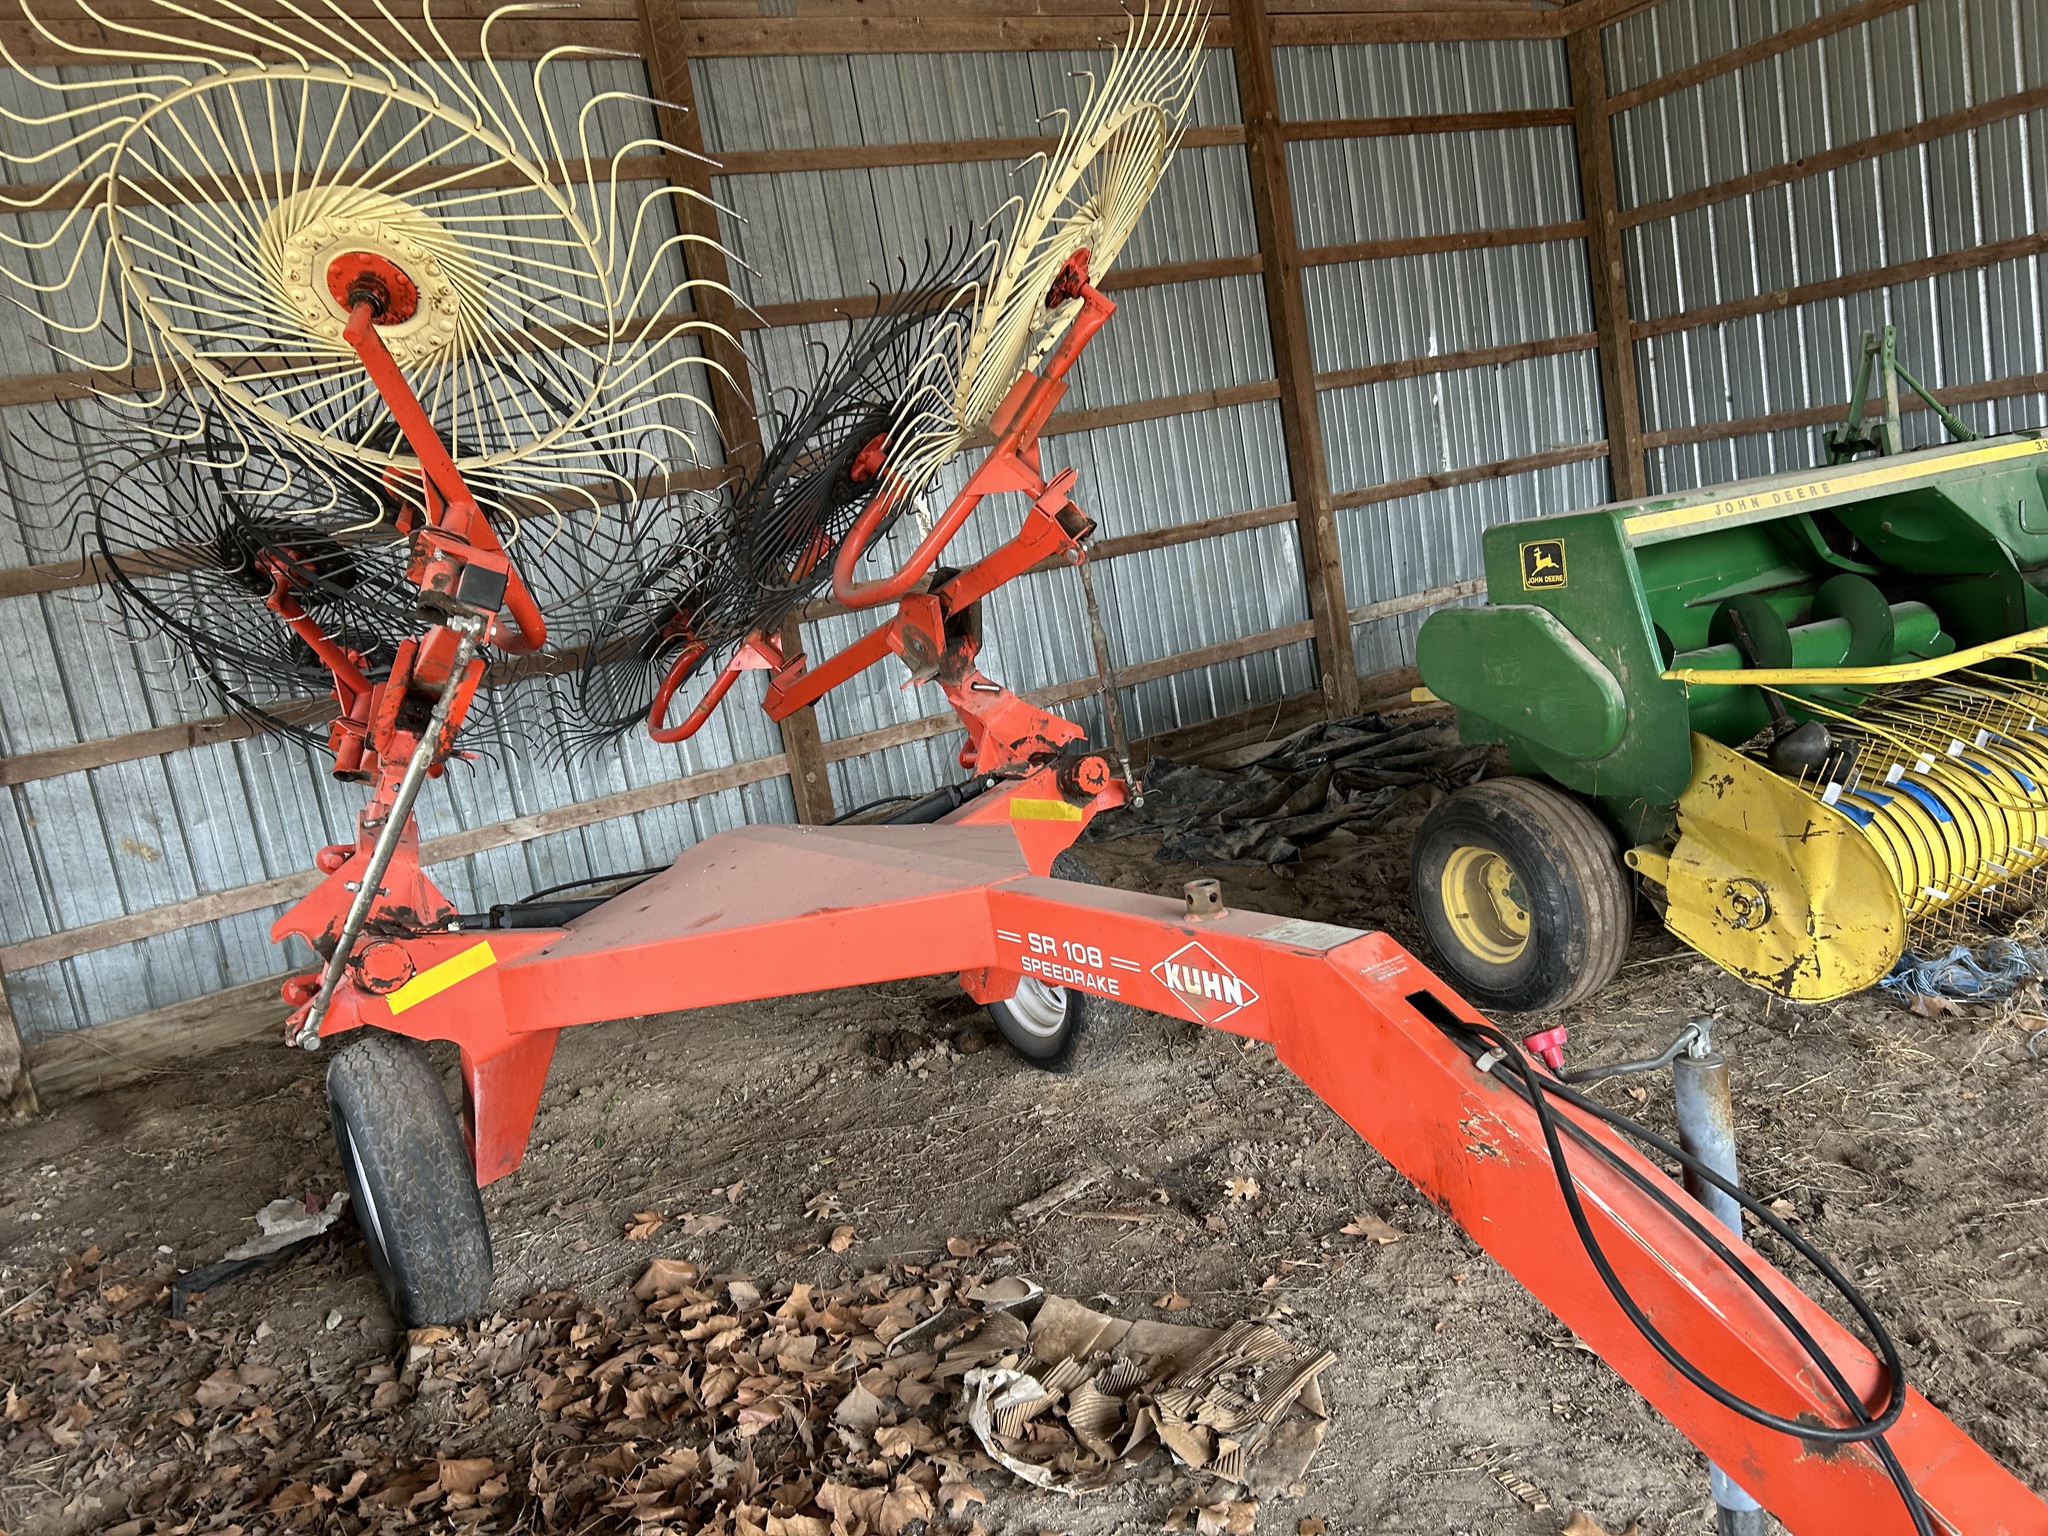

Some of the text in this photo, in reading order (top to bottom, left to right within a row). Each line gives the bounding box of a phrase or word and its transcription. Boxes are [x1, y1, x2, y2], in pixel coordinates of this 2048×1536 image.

[1715, 482, 1831, 516] JOHN DEERE
[1527, 574, 1564, 584] JOHN DEERE
[1027, 932, 1103, 969] SR 108
[1021, 955, 1121, 996] SPEEDRAKE
[1164, 962, 1244, 1007] KUHN
